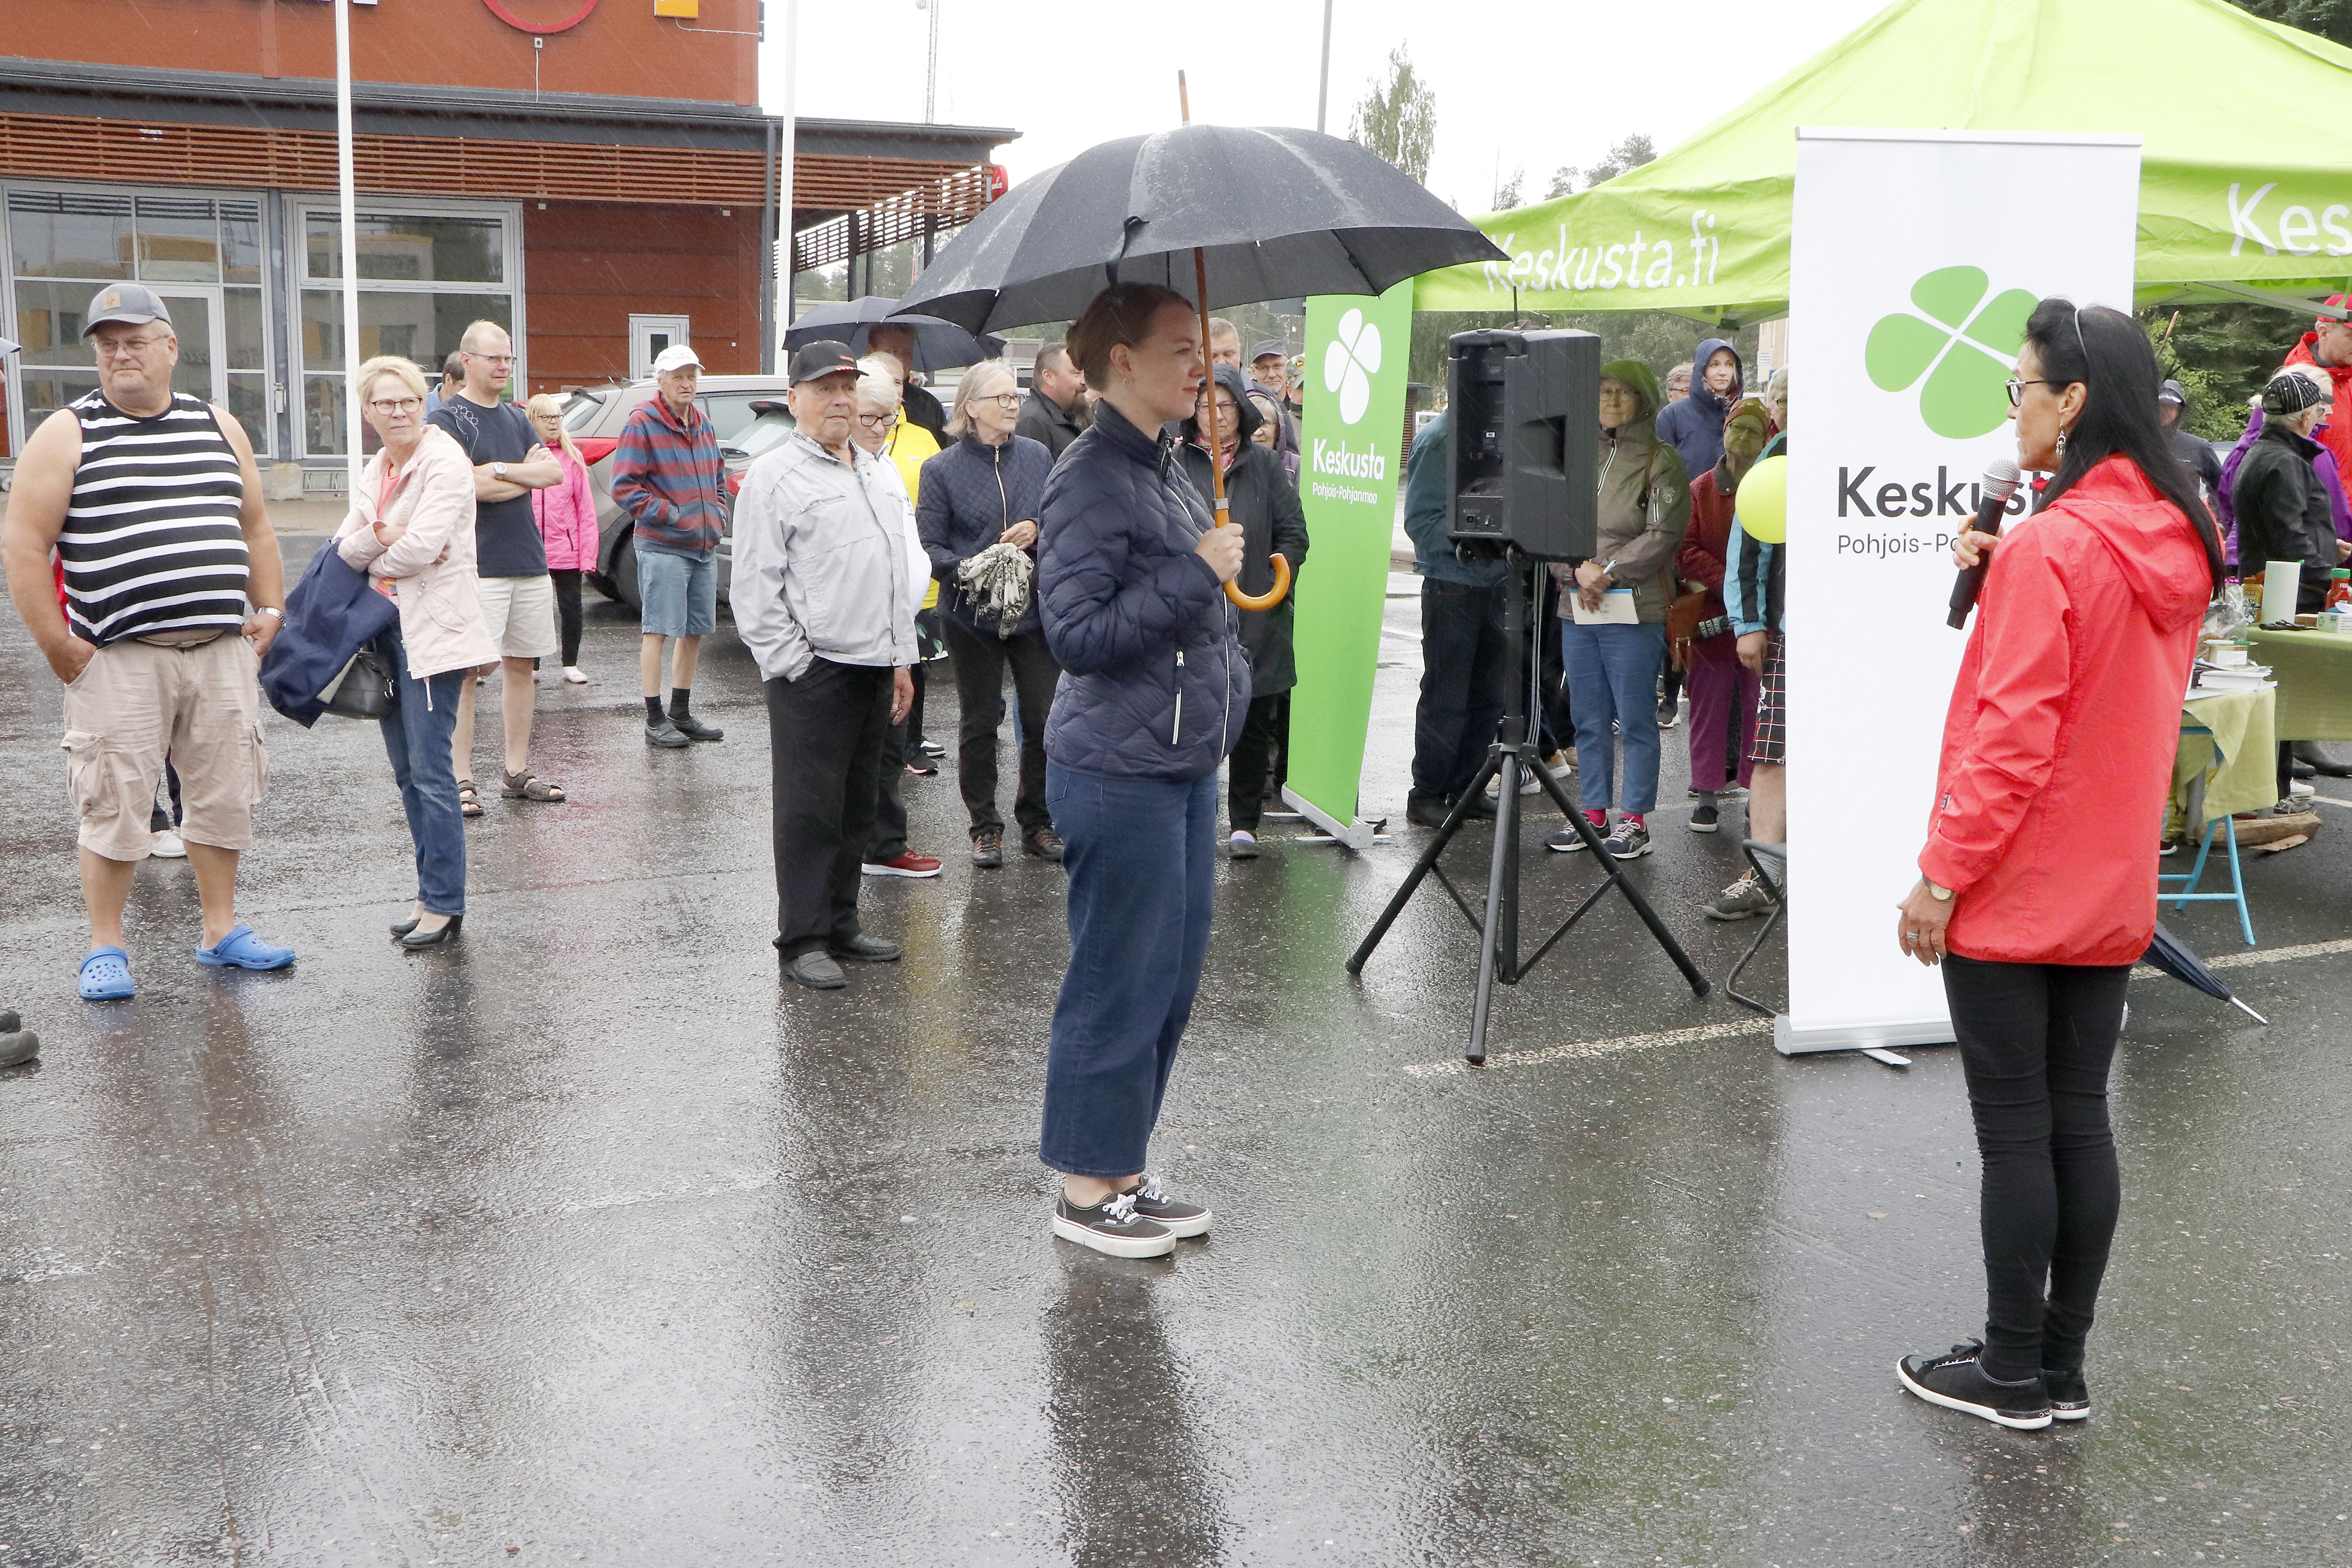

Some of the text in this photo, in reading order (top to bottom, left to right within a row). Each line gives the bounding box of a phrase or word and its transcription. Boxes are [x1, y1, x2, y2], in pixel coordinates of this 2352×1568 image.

[2228, 183, 2352, 256] Kes
[1484, 210, 1719, 292] Keskusta.fi
[1313, 438, 1385, 480] Keskusta
[1313, 482, 1377, 504] Pohjois-Pohjanmaa
